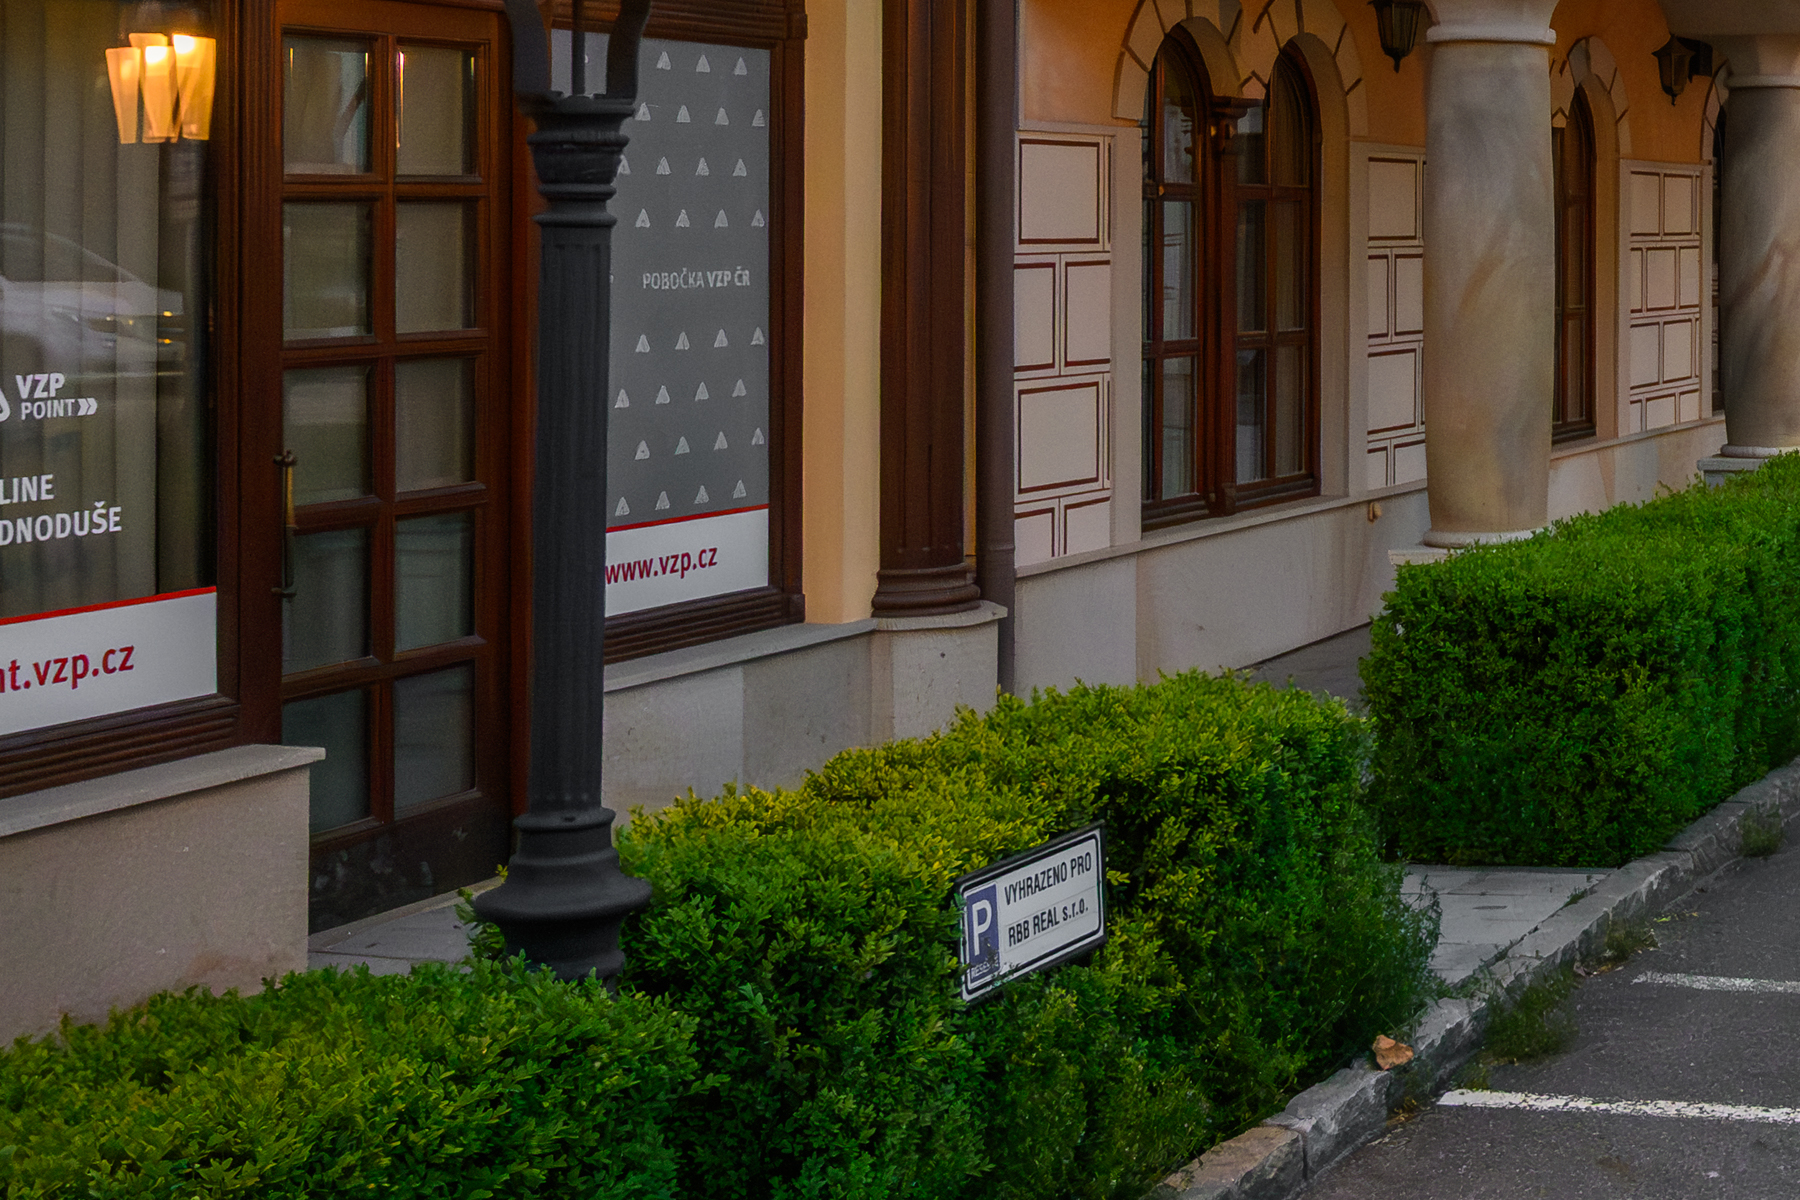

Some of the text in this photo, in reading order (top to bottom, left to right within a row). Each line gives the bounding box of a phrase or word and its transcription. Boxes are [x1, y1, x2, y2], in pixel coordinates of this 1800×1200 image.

[642, 265, 751, 290] POBOČKA VZP ČR
[15, 372, 66, 400] VZP
[21, 399, 76, 421] POINT
[605, 547, 718, 585] www.vzp.cz
[1003, 851, 1092, 906] VYHRAZENO PRO
[971, 899, 993, 957] P
[1007, 897, 1089, 948] RBB REAL s.r.o.
